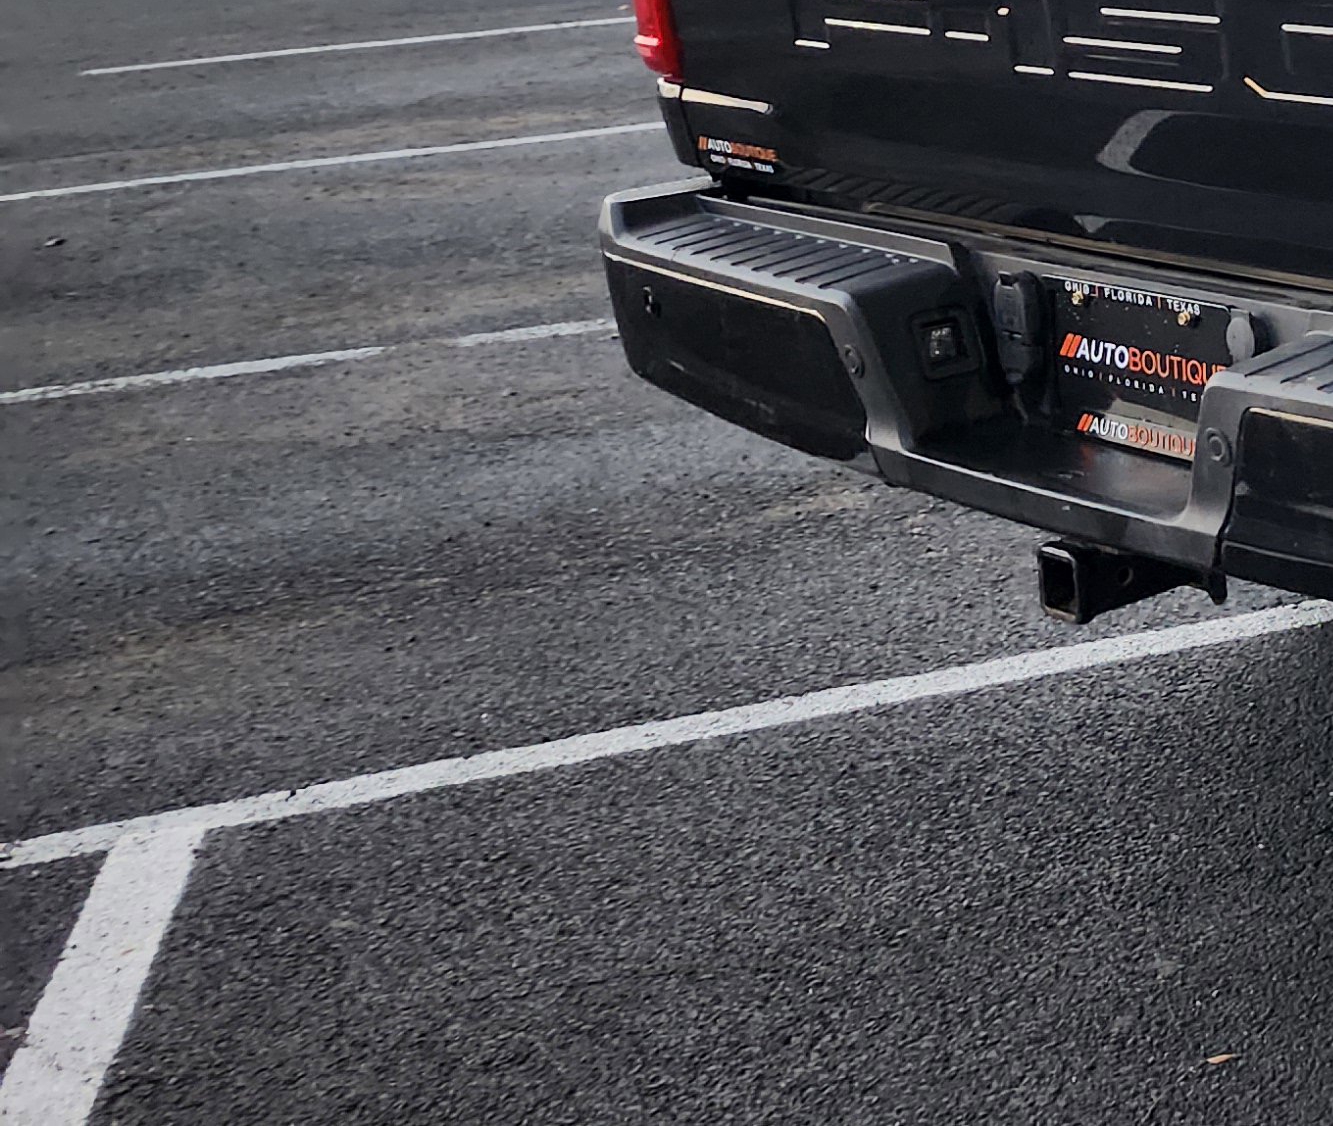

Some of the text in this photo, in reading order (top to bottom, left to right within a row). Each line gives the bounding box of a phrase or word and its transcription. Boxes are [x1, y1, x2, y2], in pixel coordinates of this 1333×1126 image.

[1065, 281, 1201, 316] OHIO FLORIDA TEXAS
[1076, 337, 1227, 386] AUTOBOUTIQU
[1108, 375, 1165, 395] FLORIDA
[1182, 390, 1197, 402] TE
[1089, 417, 1197, 456] AUTOBOUTIQU
